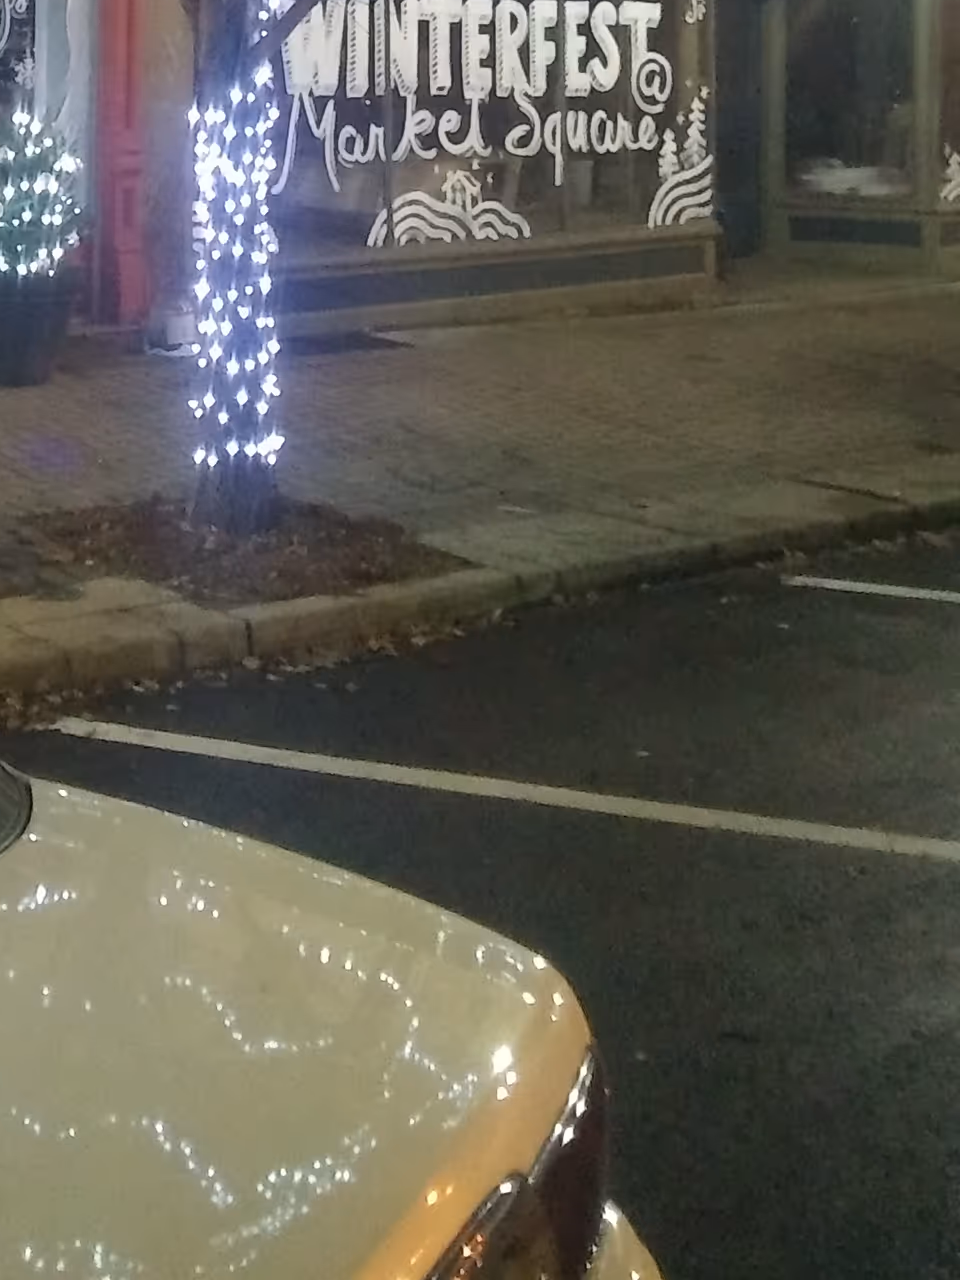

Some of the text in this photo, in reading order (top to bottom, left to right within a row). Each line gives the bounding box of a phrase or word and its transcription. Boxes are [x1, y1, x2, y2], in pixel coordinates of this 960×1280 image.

[631, 52, 673, 114] @
[271, 86, 660, 194] Market Square
